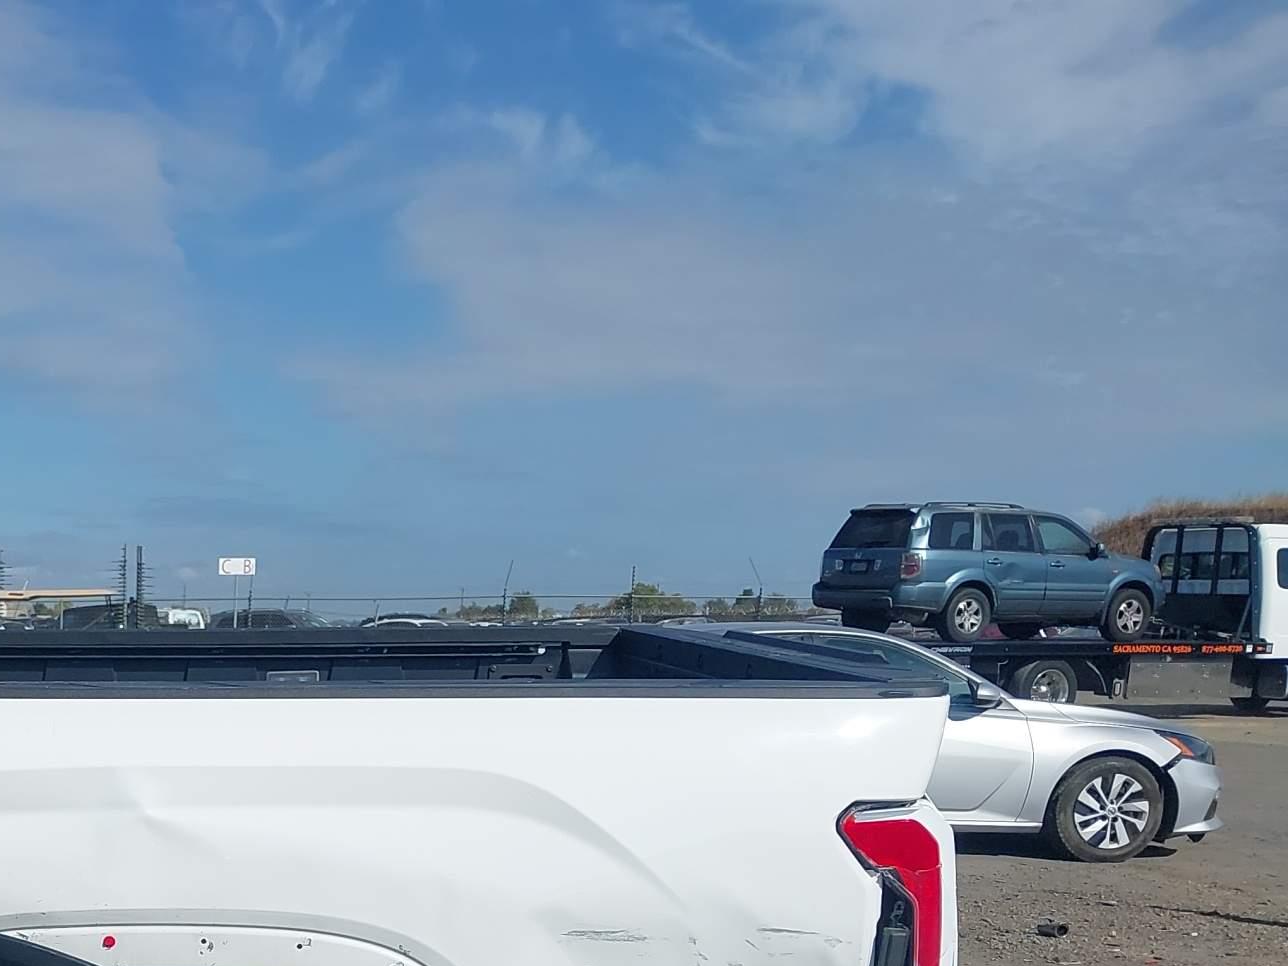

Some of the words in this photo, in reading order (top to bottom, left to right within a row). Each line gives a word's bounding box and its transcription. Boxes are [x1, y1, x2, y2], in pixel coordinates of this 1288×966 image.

[222, 559, 231, 574] C
[244, 559, 252, 574] B
[1113, 645, 1161, 654] SACRAMENTO
[1162, 645, 1172, 654] CA
